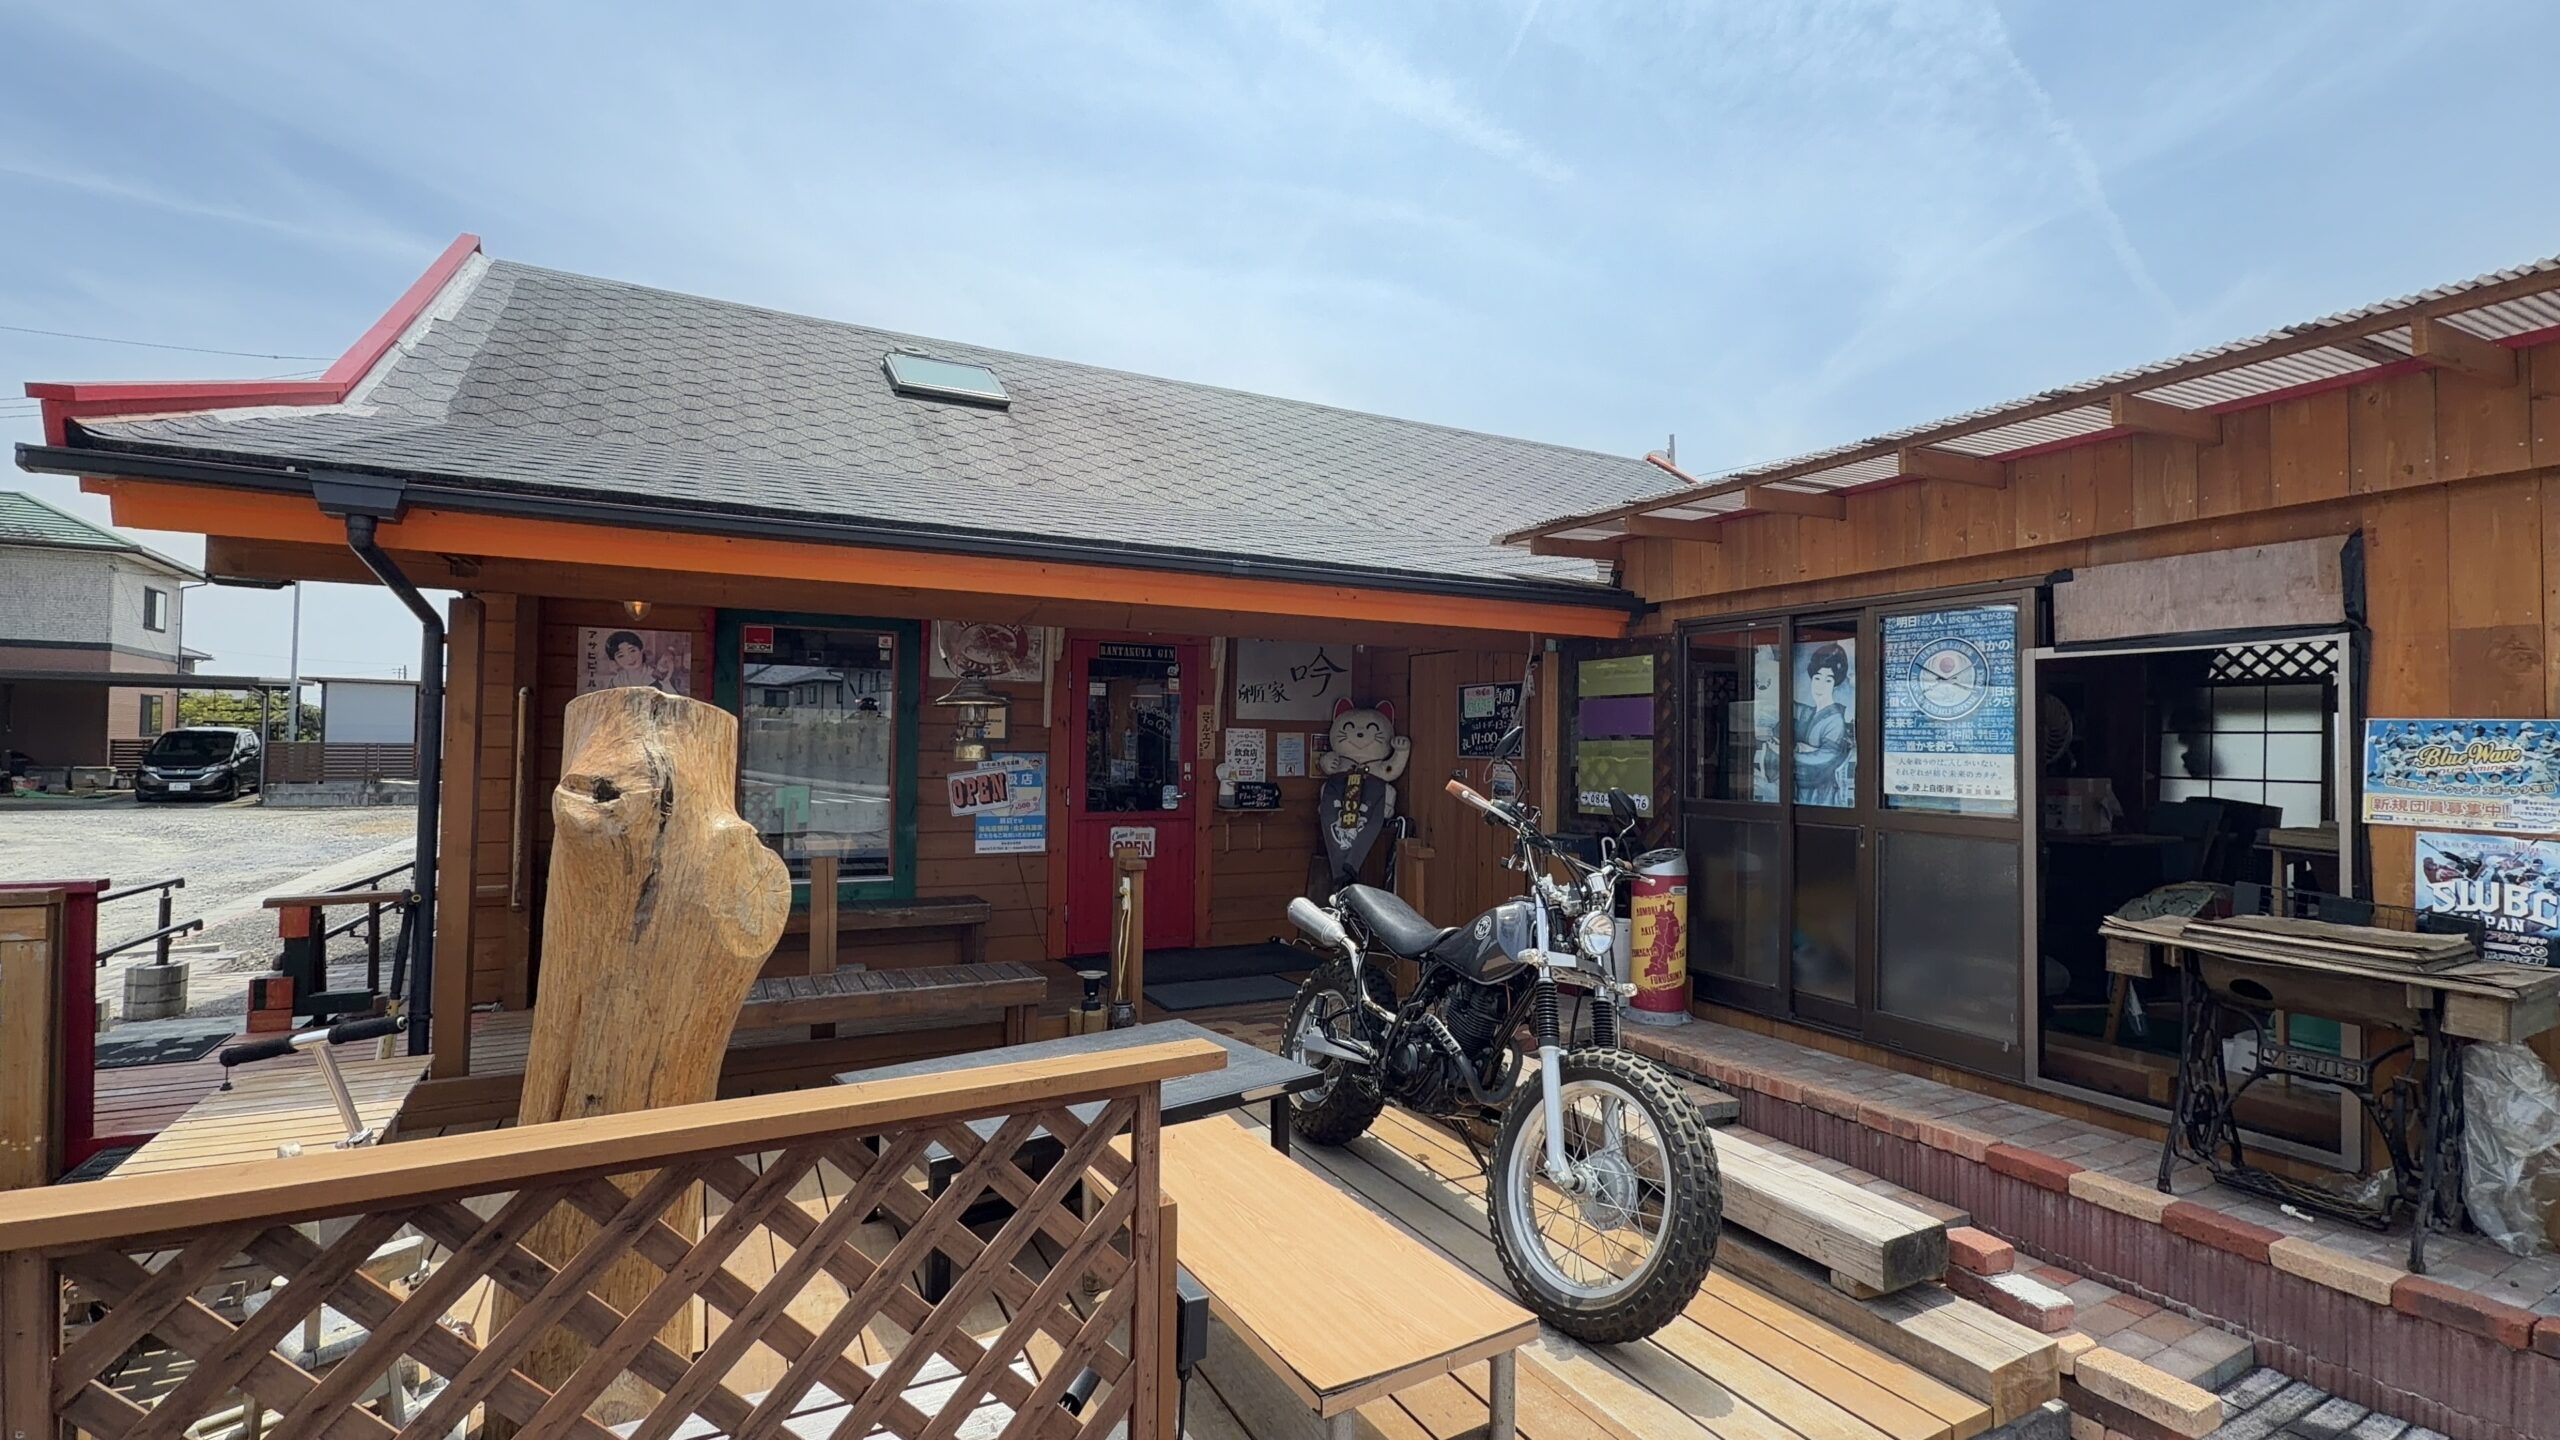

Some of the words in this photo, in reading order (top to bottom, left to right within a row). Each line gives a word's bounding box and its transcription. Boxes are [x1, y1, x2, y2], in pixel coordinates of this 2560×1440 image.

[587, 630, 598, 688] アサヒビール
[1290, 646, 1348, 697] 吟
[2415, 745, 2469, 768] Blue
[2467, 741, 2522, 763] Wave
[951, 772, 1009, 808] OPEN
[1911, 783, 1954, 793] 陸上自衛隊
[2427, 879, 2558, 929] SWBC
[2262, 1048, 2359, 1082] VENUS
